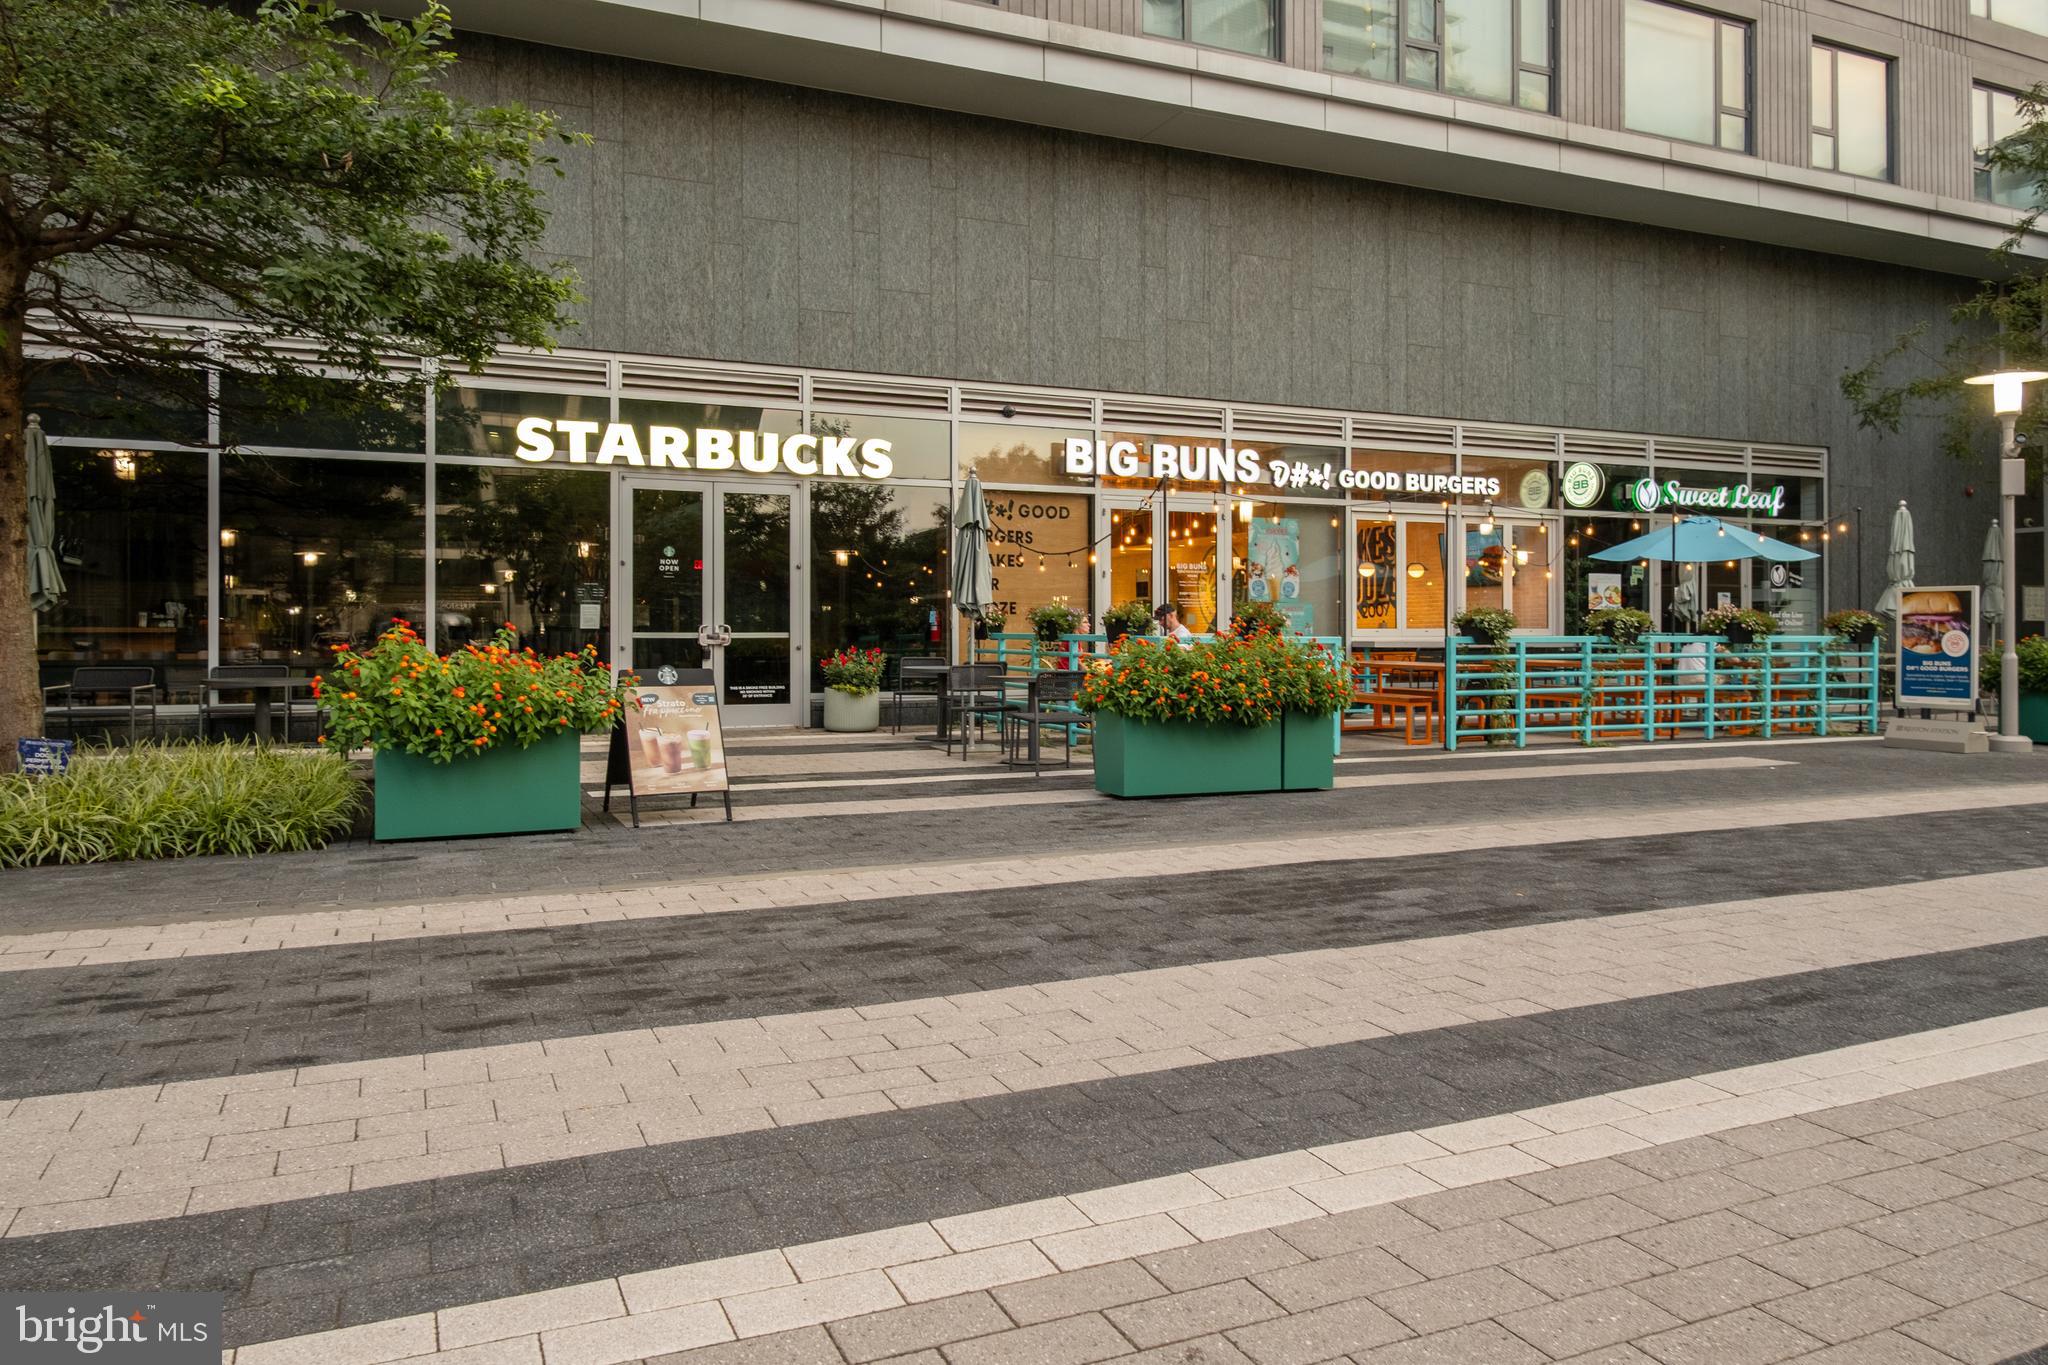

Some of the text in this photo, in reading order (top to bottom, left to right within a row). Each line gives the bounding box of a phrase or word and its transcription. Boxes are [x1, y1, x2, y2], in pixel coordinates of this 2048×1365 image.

[515, 417, 893, 479] STARBUCKS
[1065, 438, 1139, 477] BIG
[1151, 443, 1261, 483] BUNS
[1338, 470, 1400, 491] GOOD
[1405, 473, 1500, 496] BURGERS
[1018, 504, 1070, 519] GOOD
[1663, 480, 1785, 517] Sweet Leaf
[985, 529, 1033, 545] RGERS
[990, 553, 1025, 568] AKES
